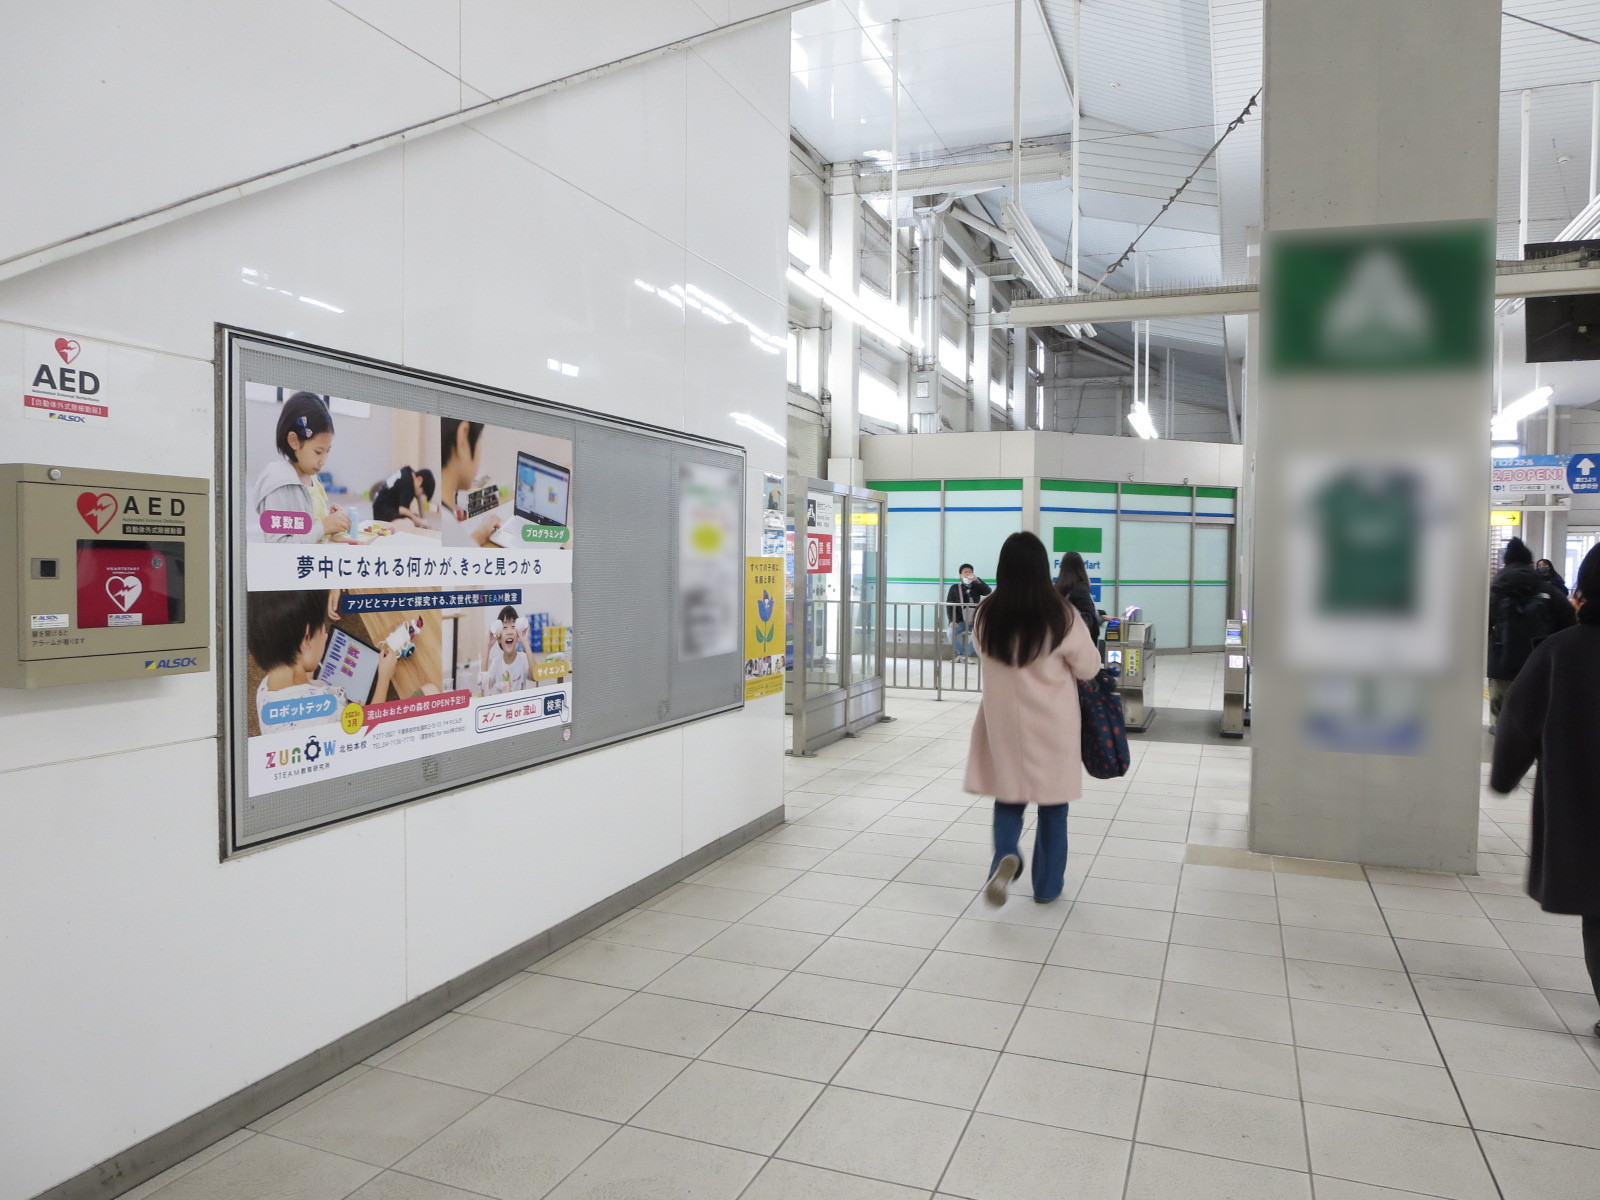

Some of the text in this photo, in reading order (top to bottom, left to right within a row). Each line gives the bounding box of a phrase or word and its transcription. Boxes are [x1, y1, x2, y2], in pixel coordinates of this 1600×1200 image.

[32, 364, 100, 395] AED
[57, 414, 85, 423] ALSOK
[123, 496, 186, 516] AED
[270, 515, 305, 530] 算数脳
[526, 528, 565, 539] プログラミング
[296, 555, 542, 579] 夢中になれる何かが、きっと見つかる
[156, 657, 198, 669] ALSOK
[537, 665, 566, 677] サイエンス
[270, 699, 332, 718] ロボットテック
[506, 708, 513, 720] 柏
[514, 710, 522, 718] or
[347, 719, 358, 728] 3月
[339, 740, 368, 754] 北柏本校
[274, 762, 330, 780] STEAM教育研究所
